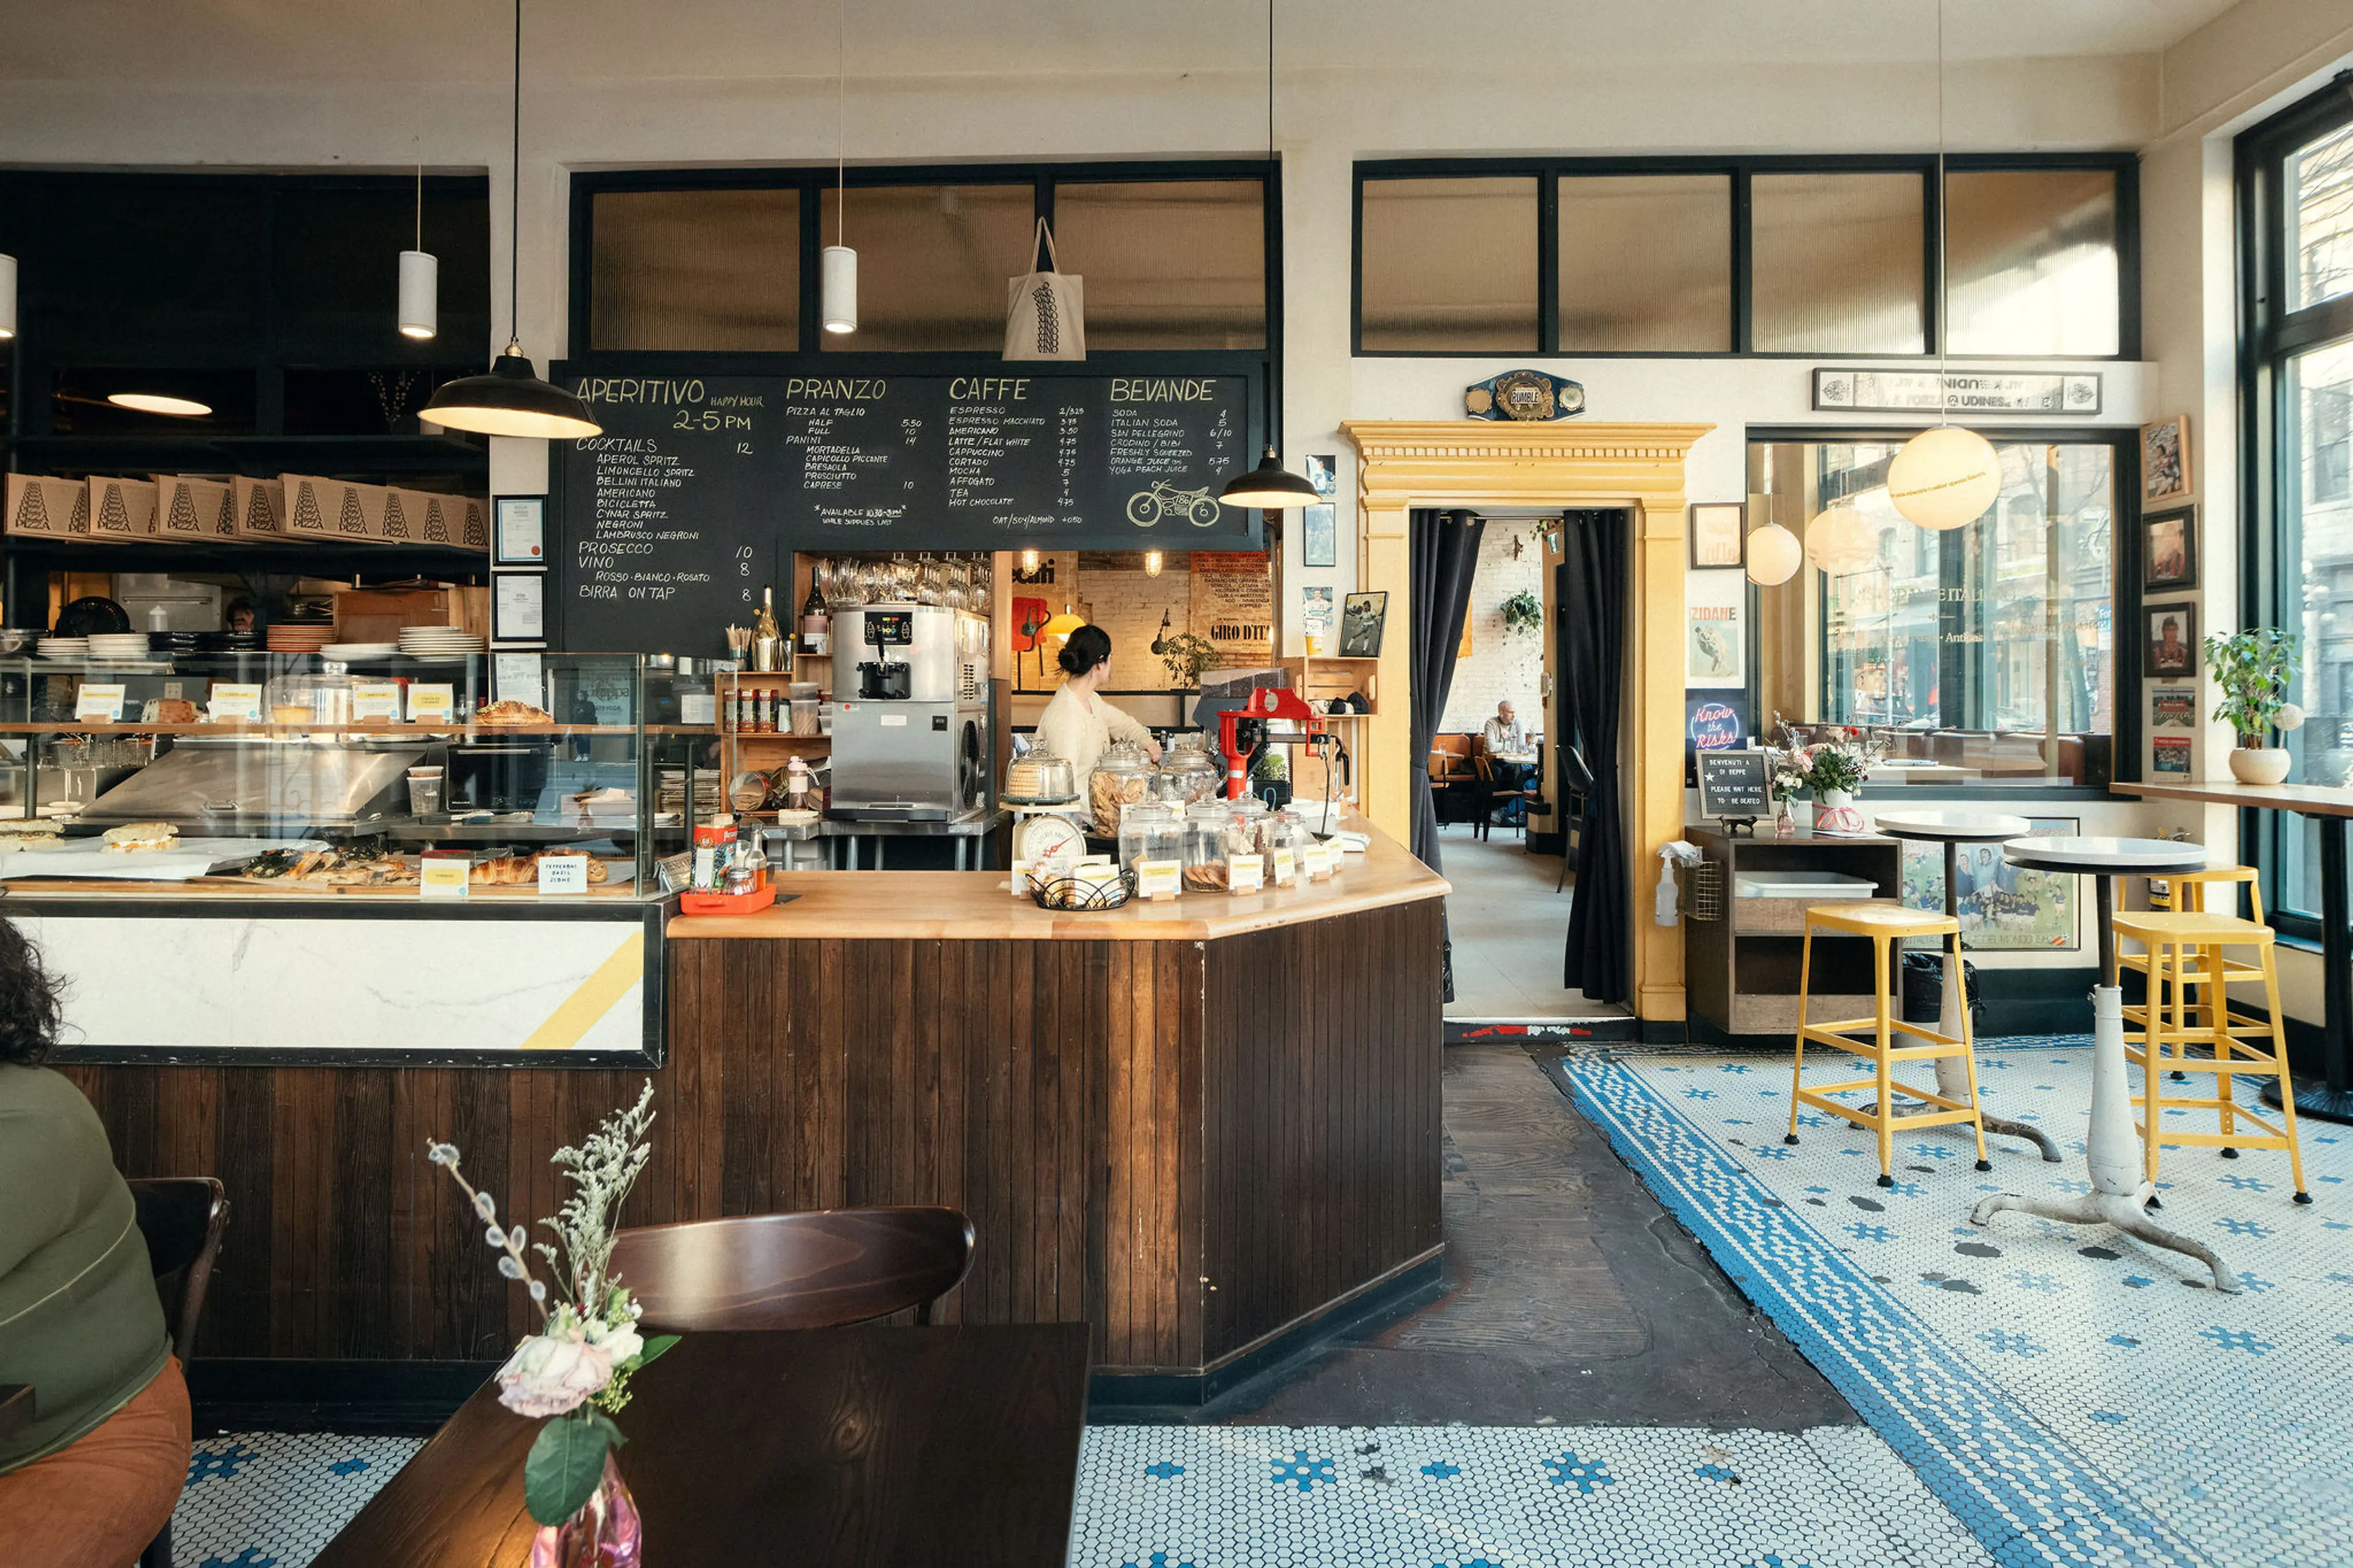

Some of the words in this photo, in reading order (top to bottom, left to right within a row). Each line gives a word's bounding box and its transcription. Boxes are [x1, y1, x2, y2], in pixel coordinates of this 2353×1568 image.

[577, 378, 705, 404] APERITIVO
[711, 396, 737, 407] HAPPY
[740, 397, 765, 407] HOUR
[786, 378, 886, 400] PRANZO
[950, 377, 1031, 401] CAFFE
[1110, 378, 1217, 403] BEVANDE
[1512, 391, 1539, 403] RUMBLE
[786, 406, 816, 416] PIZZA
[819, 407, 831, 416] AL
[834, 407, 865, 416] TAGLIO
[950, 406, 1006, 415] ESPRESSO
[1220, 409, 1227, 419] 4
[726, 415, 751, 430] PM
[1111, 419, 1150, 427] ITALIAN
[1153, 419, 1178, 427] SODA
[1218, 419, 1227, 427] 5
[1110, 429, 1129, 438] SAN
[1132, 429, 1185, 438] PELLEGRINO
[576, 437, 657, 453] COCKTAILS
[737, 442, 753, 455] 12
[786, 436, 821, 444] PANINI
[905, 436, 917, 446] 14
[949, 437, 975, 446] LATTE
[1110, 439, 1151, 447] CRODINO
[1216, 441, 1223, 450] 7
[806, 445, 860, 455] MORTADELLA
[949, 448, 1005, 456] CAPPUCCINO
[1110, 448, 1150, 456] FRESHLY
[1154, 449, 1192, 458] SQUEEZED
[596, 453, 638, 466] APEROL
[642, 455, 680, 466] SPRITZ
[596, 466, 660, 477] LIMONCELLO
[664, 468, 695, 477] SPRITZ
[805, 472, 857, 480] PROSCIUTTO
[1110, 466, 1131, 475] YOGA
[1216, 466, 1222, 475] 4
[596, 477, 637, 486] BELLINI
[640, 478, 681, 488] ITALIANO
[803, 481, 843, 490] CAPRESE
[903, 481, 914, 490] 10
[950, 477, 995, 486] AFFOGATO
[596, 488, 656, 499] AMERICANO
[950, 488, 969, 498] TEA
[597, 499, 657, 509] BICICLETTA
[969, 498, 1014, 506] CHOCOLATE
[596, 509, 629, 519] CYNAR
[634, 510, 669, 520] SPRITZ
[820, 508, 864, 517] AVAILABLE
[596, 520, 643, 529] NEGRONI
[596, 530, 653, 540] LAMBRUSCO
[656, 531, 699, 540] NEGRONI
[579, 541, 653, 555] PROSECCO
[735, 546, 752, 558] 10
[578, 556, 614, 569] VINO
[740, 562, 750, 577] 8
[596, 570, 629, 582] ROSSO
[634, 572, 670, 582] BIANCO
[676, 572, 710, 582] ROSATO
[579, 585, 618, 599] BIRRA
[628, 586, 646, 599] ON
[649, 587, 675, 600] TAP
[742, 588, 751, 602] 8
[1691, 607, 1737, 621] ZIDANE
[1211, 624, 1240, 640] GIRO
[1695, 706, 1734, 722] Know
[1707, 721, 1722, 733] the
[1697, 730, 1737, 748] Risks
